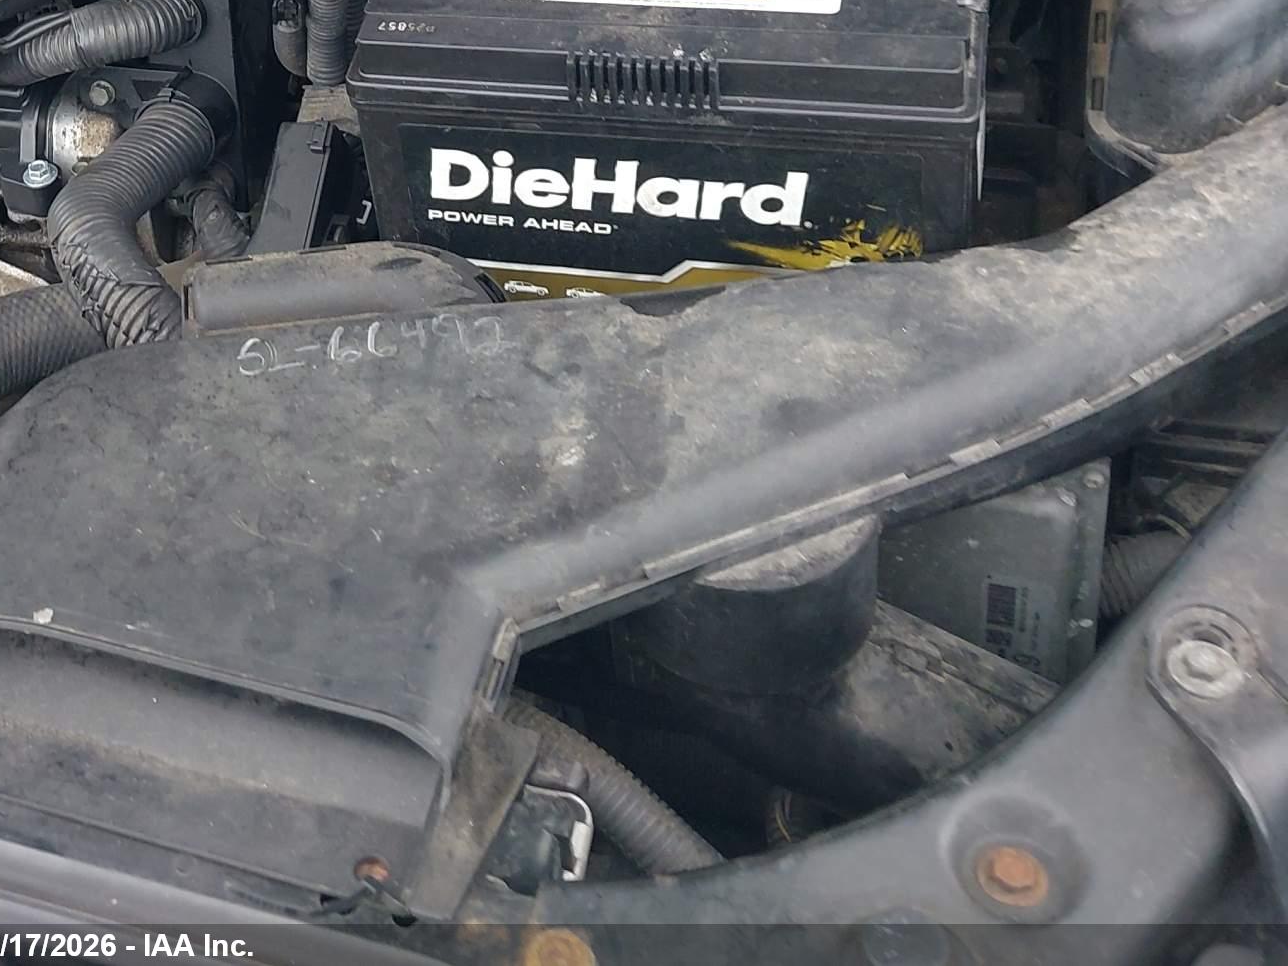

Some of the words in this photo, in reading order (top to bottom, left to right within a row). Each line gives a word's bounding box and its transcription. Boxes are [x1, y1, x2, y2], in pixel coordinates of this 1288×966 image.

[429, 147, 810, 229] DieHard
[428, 209, 515, 228] POWER
[523, 218, 613, 235] AHEAD
